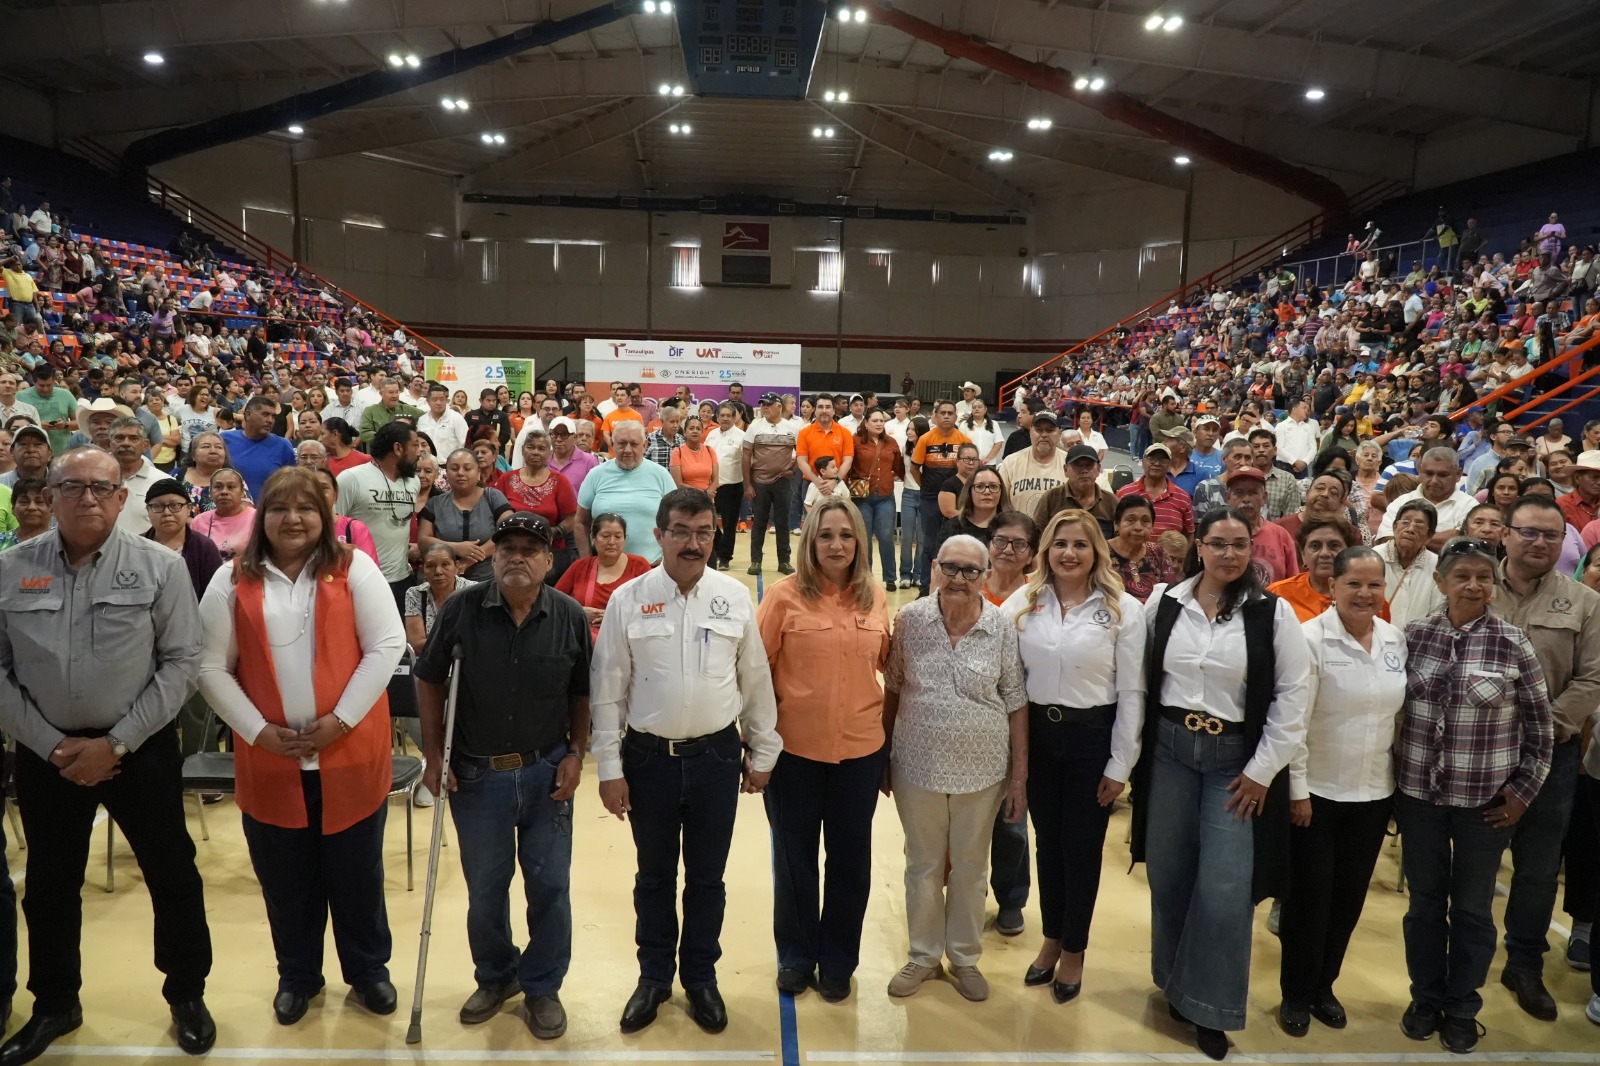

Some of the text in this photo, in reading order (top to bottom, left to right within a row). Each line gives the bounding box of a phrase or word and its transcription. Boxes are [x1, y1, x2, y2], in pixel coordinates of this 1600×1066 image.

[669, 346, 684, 357] DIF
[696, 348, 722, 359] UAT
[1012, 477, 1064, 496] PUMA TEA
[21, 576, 53, 589] UAT
[641, 602, 665, 614] UAT
